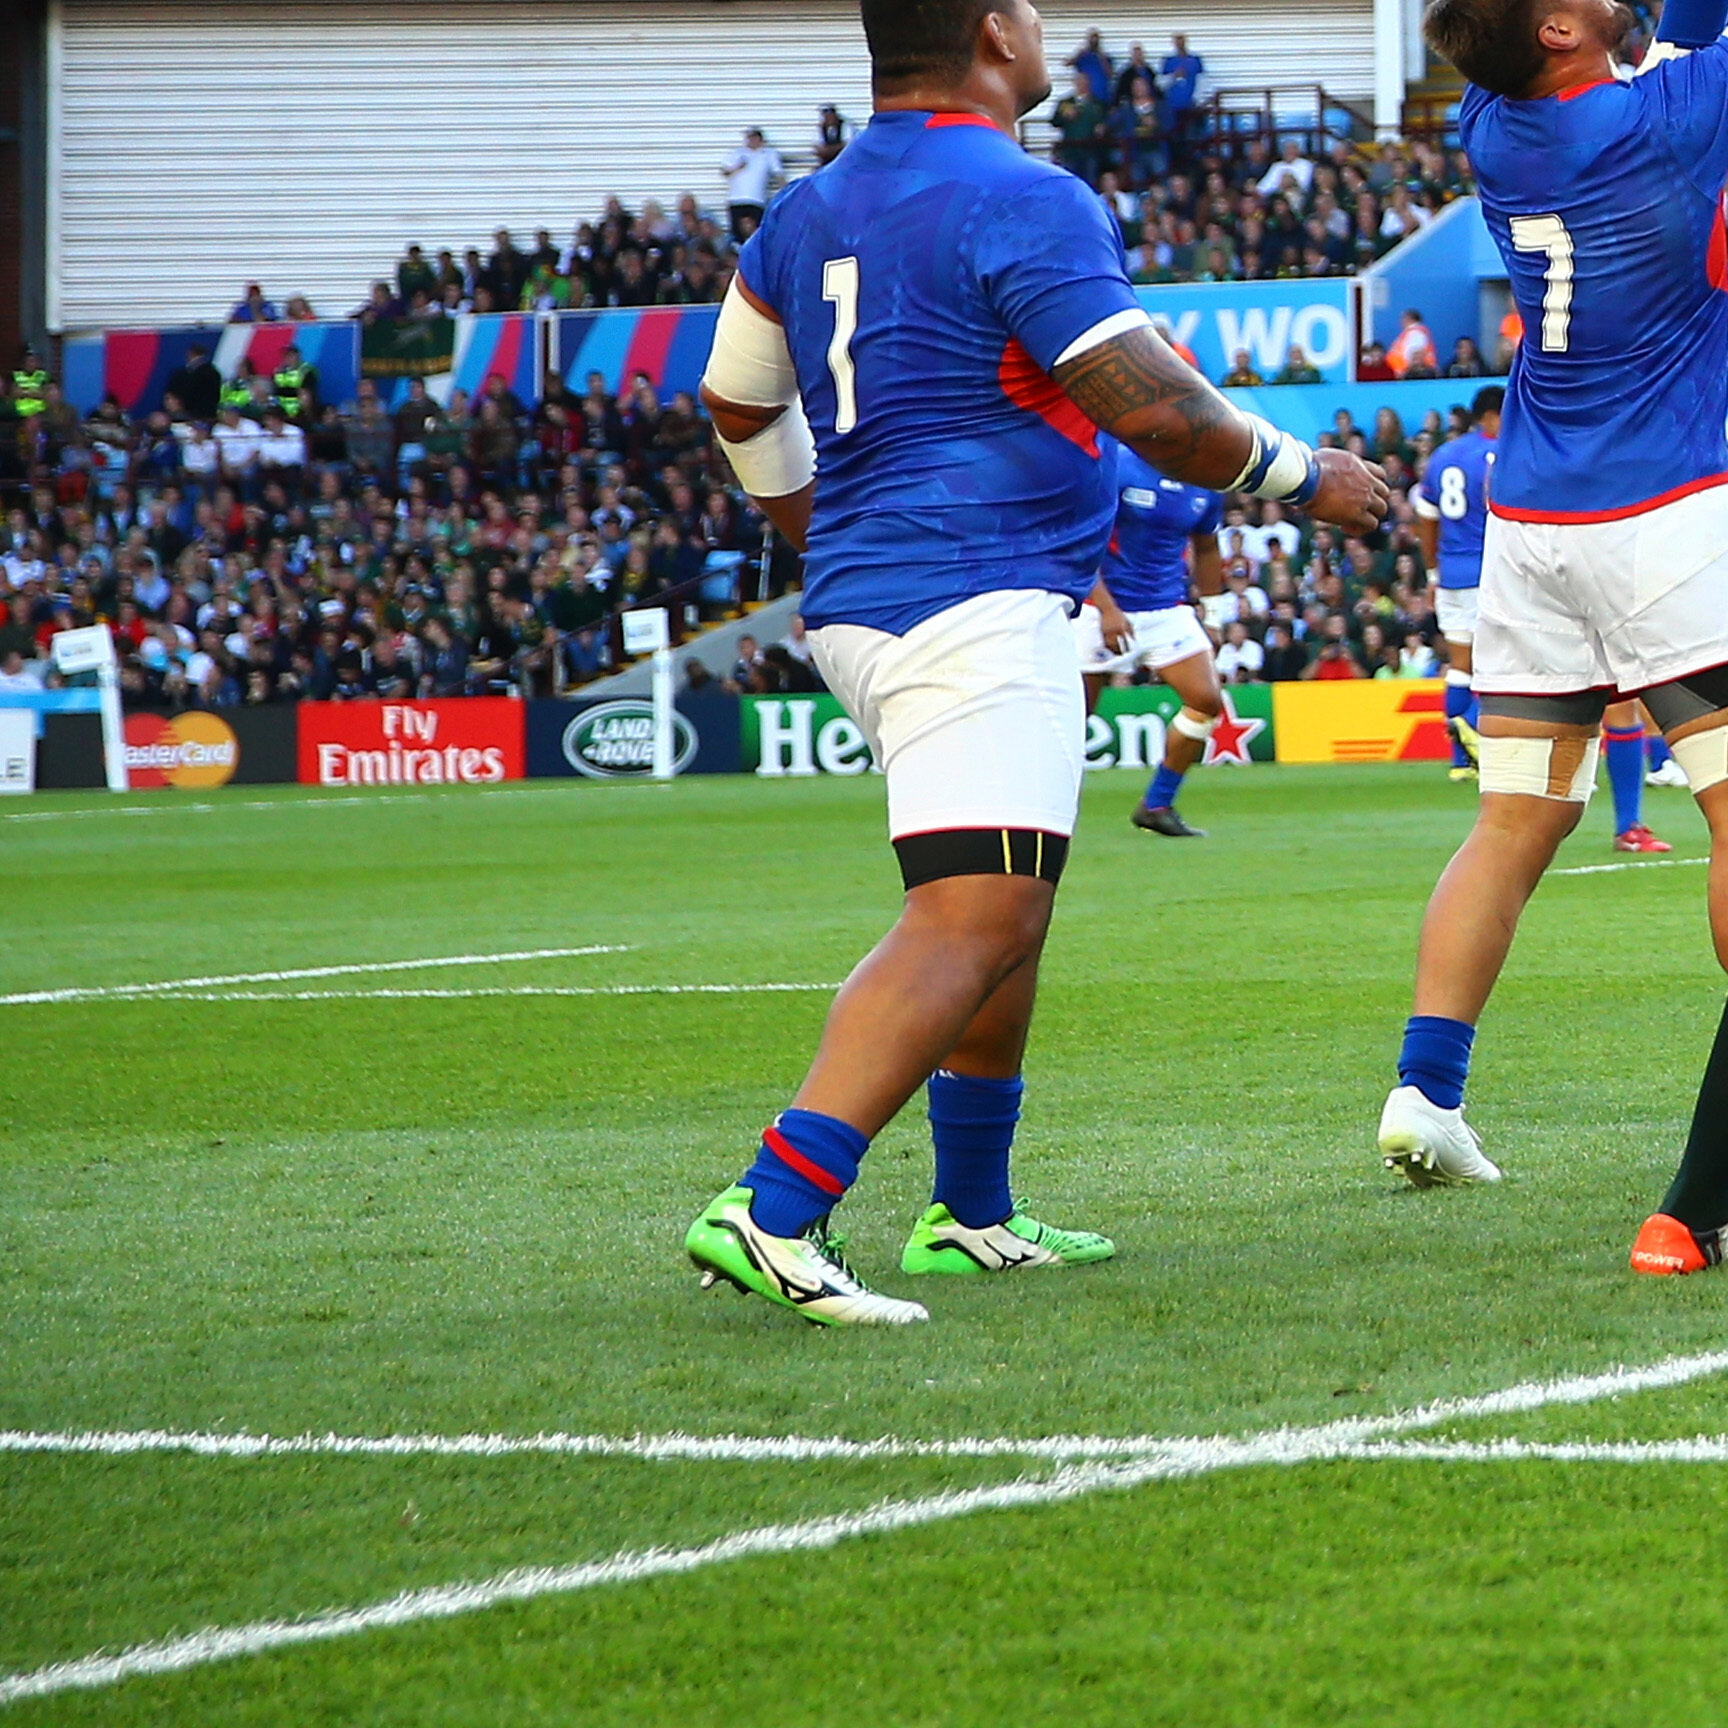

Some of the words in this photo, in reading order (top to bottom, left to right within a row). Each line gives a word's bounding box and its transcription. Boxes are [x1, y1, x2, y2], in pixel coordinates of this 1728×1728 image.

[1509, 213, 1576, 353] 7
[822, 256, 858, 433] 1
[1439, 465, 1468, 520] 8
[382, 705, 438, 744] Fly
[592, 717, 656, 739] LAND
[122, 740, 237, 768] asterCard
[318, 739, 505, 785] Emirates
[598, 741, 656, 766] ROVE
